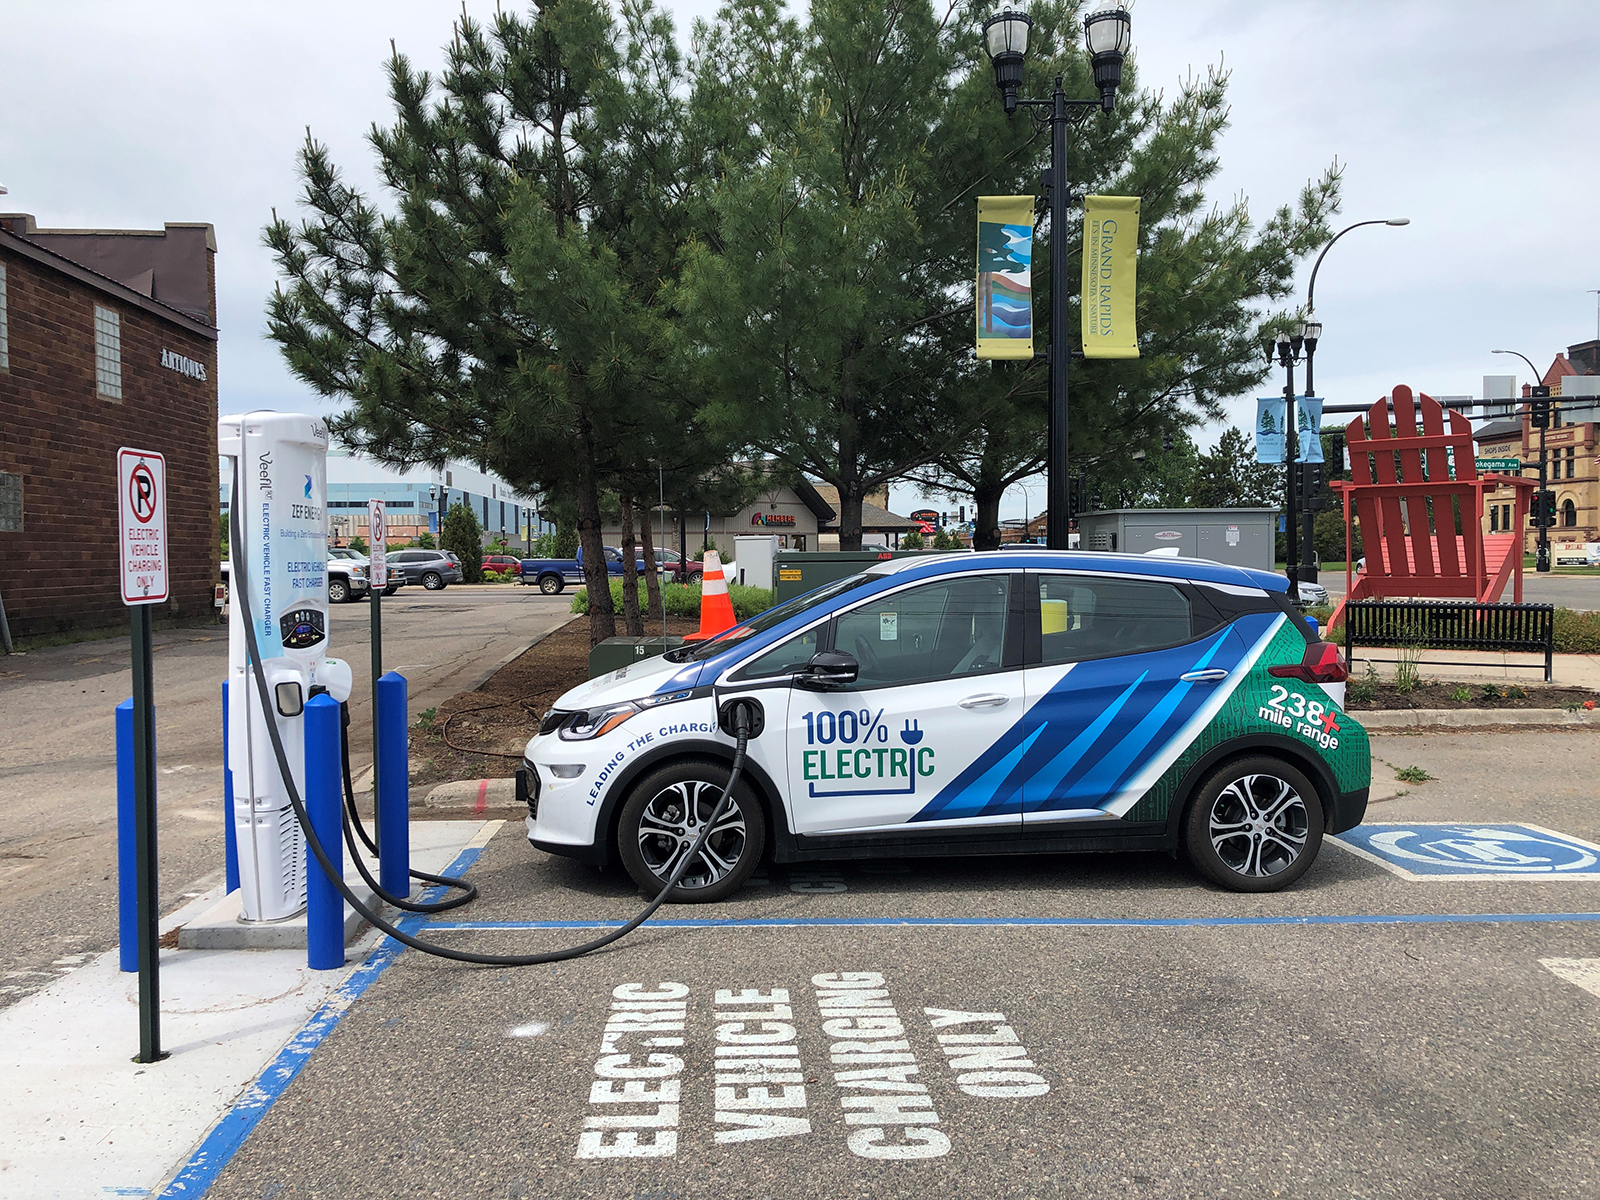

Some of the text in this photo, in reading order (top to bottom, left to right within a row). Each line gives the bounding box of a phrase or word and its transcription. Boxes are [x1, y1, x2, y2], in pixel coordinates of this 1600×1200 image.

[1092, 220, 1100, 234] IT'S
[1092, 236, 1099, 246] IN
[1099, 219, 1118, 337] GRAND RAPIDS
[1090, 303, 1098, 335] NATURE
[159, 347, 207, 381] ANTIQUES
[1484, 444, 1511, 455] SHOPS INSIDE
[259, 450, 273, 491] Veefil
[1475, 461, 1506, 470] okegama
[291, 504, 304, 518] ZEF
[128, 528, 160, 541] ELECTRIC
[280, 529, 296, 540] Building
[130, 544, 159, 557] VEHICLE
[877, 552, 892, 560] ABB
[127, 559, 162, 573] CHARGING
[262, 502, 272, 637] ELECTRIC VEHICLE FAST CHARGER
[287, 561, 310, 573] ELECTRIC
[136, 575, 155, 588] ONLY
[292, 577, 305, 589] FAST
[634, 645, 645, 655] 15
[801, 707, 889, 745] 100%
[1258, 706, 1339, 750] mile range
[586, 751, 625, 806] LEADING
[627, 731, 655, 752] THE
[802, 746, 935, 780] ELECTRIC
[923, 1006, 1051, 1098] ONLY
[575, 981, 691, 1160] ELECTRIC
[713, 988, 813, 1145] VEHICLE
[811, 971, 952, 1160] CHARGING
